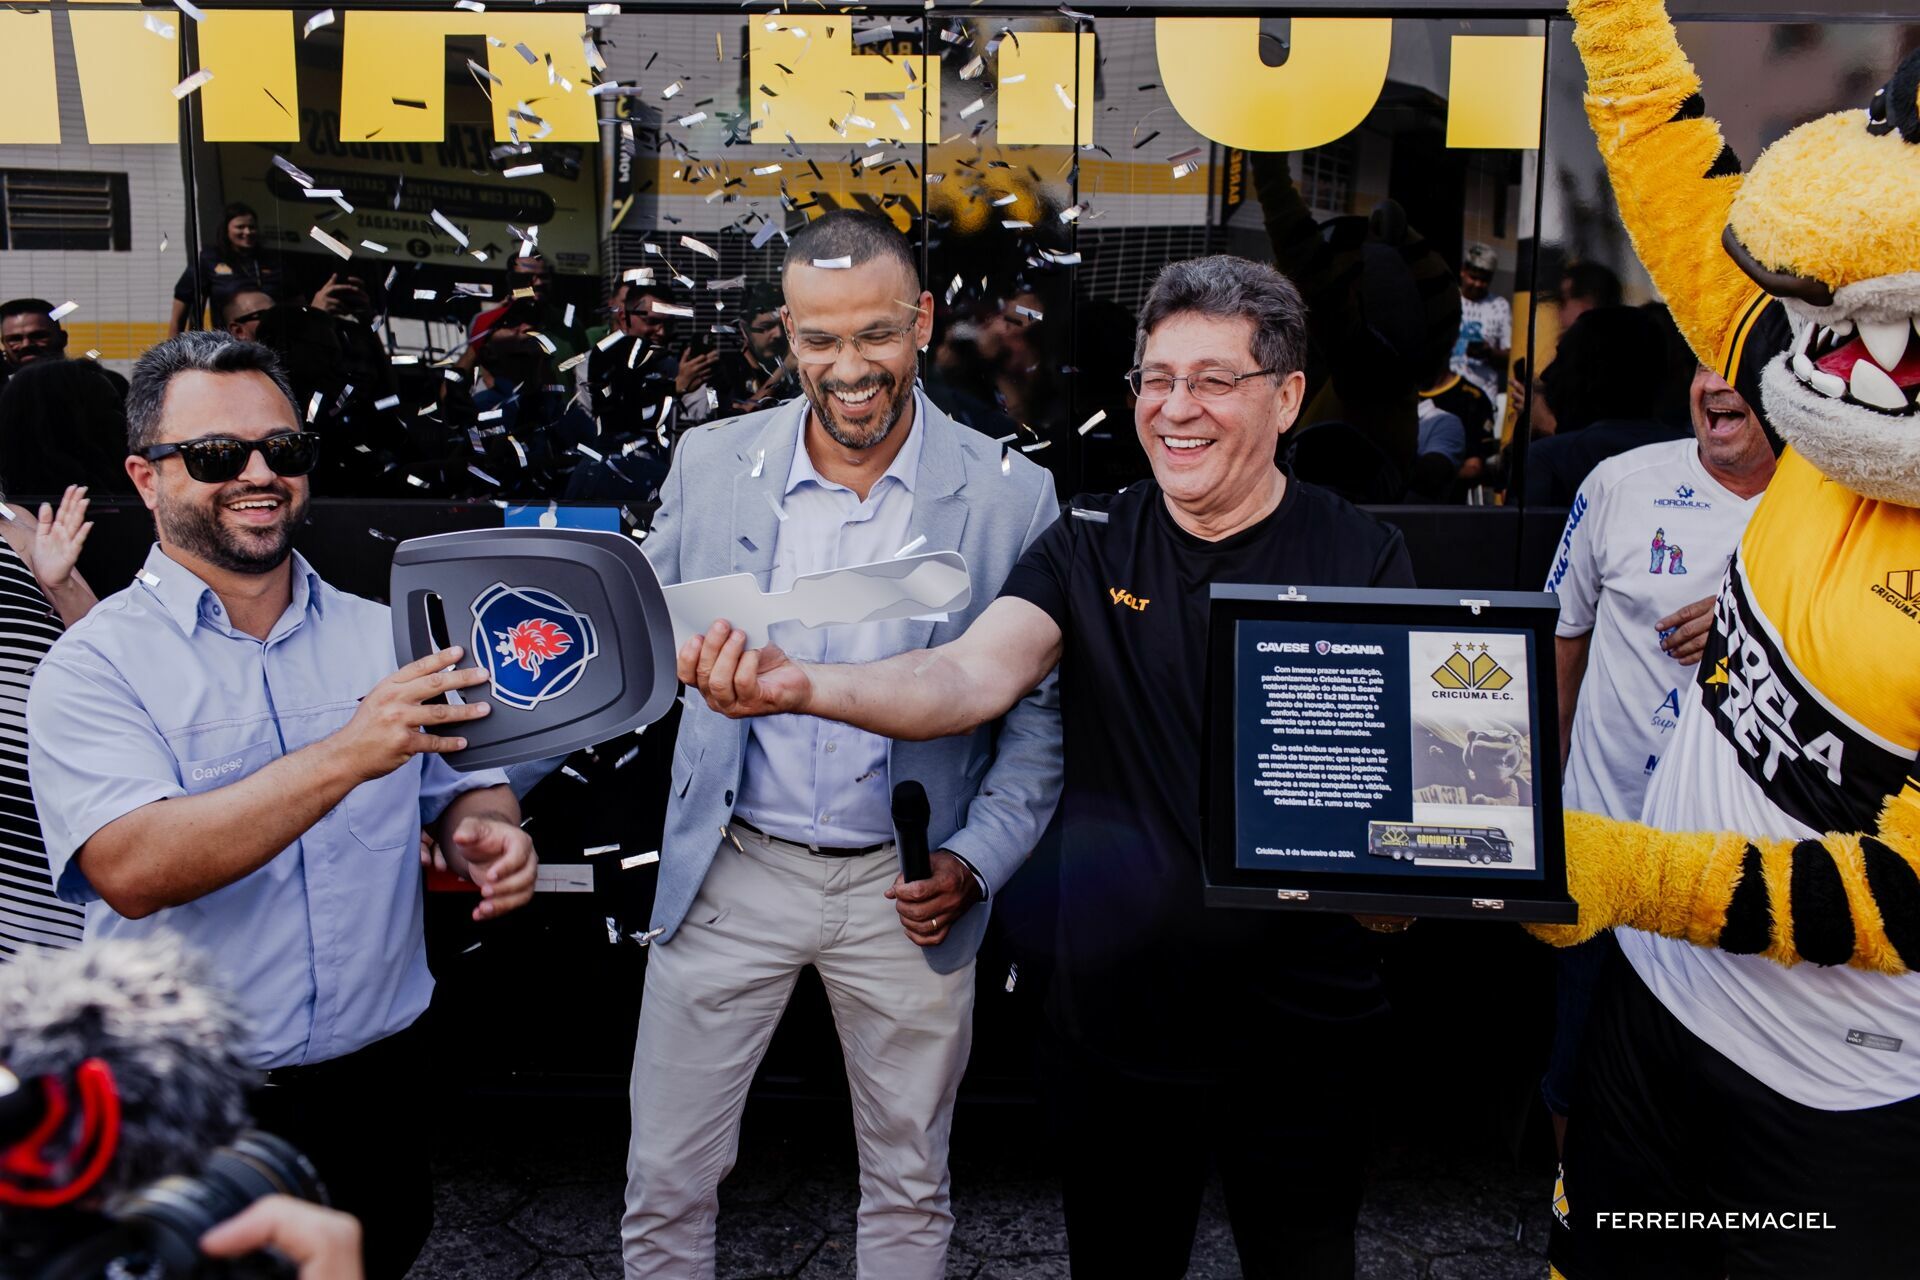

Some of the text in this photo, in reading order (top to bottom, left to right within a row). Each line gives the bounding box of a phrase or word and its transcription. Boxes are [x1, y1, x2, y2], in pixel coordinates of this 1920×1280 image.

[1653, 498, 1712, 510] HIDROMUCK
[1109, 587, 1150, 611] VOLT
[1257, 642, 1384, 655] CAVESE SCANIA
[1292, 666, 1316, 674] imenso
[1346, 668, 1382, 676] satisfação,
[1261, 674, 1312, 683] parabenizamos
[1319, 676, 1351, 684] Criciúma
[1288, 684, 1320, 692] aquisição
[1332, 684, 1357, 692] ônibus
[1432, 689, 1514, 701] CRICIÚMA E.C.
[1304, 702, 1336, 710] inovação,
[1337, 703, 1373, 711] segurança
[1271, 709, 1301, 717] conforto,
[1302, 710, 1333, 718] refletindo
[1340, 711, 1364, 719] padrão
[1260, 718, 1296, 726] excelência
[1297, 719, 1311, 727] que
[1318, 719, 1336, 727] clube
[1719, 669, 1799, 782] BET
[1333, 728, 1372, 736] dimensões.
[1272, 744, 1287, 752] Que
[1304, 745, 1327, 753] ônibus
[1328, 746, 1343, 754] seja
[1351, 756, 1365, 764] seja
[191, 757, 243, 781] Cavese
[1271, 762, 1308, 770] movimento
[1351, 764, 1387, 773] jogadores,
[1296, 771, 1320, 779] técnica
[1327, 773, 1351, 781] equipe
[1352, 773, 1361, 781] de
[1362, 774, 1383, 782] apoio,
[1254, 779, 1292, 787] levando-os
[1321, 782, 1358, 790] conquistas
[1365, 782, 1392, 791] vitórias,
[1263, 789, 1308, 797] simbolizando
[1315, 790, 1341, 798] jornada
[1274, 798, 1307, 806] Criciúma
[1308, 799, 1323, 807] E.C.
[1354, 801, 1372, 809] topo.
[1255, 847, 1285, 856] Criciúma,
[1300, 849, 1328, 857] fevereiro
[1338, 850, 1356, 858] 2024.
